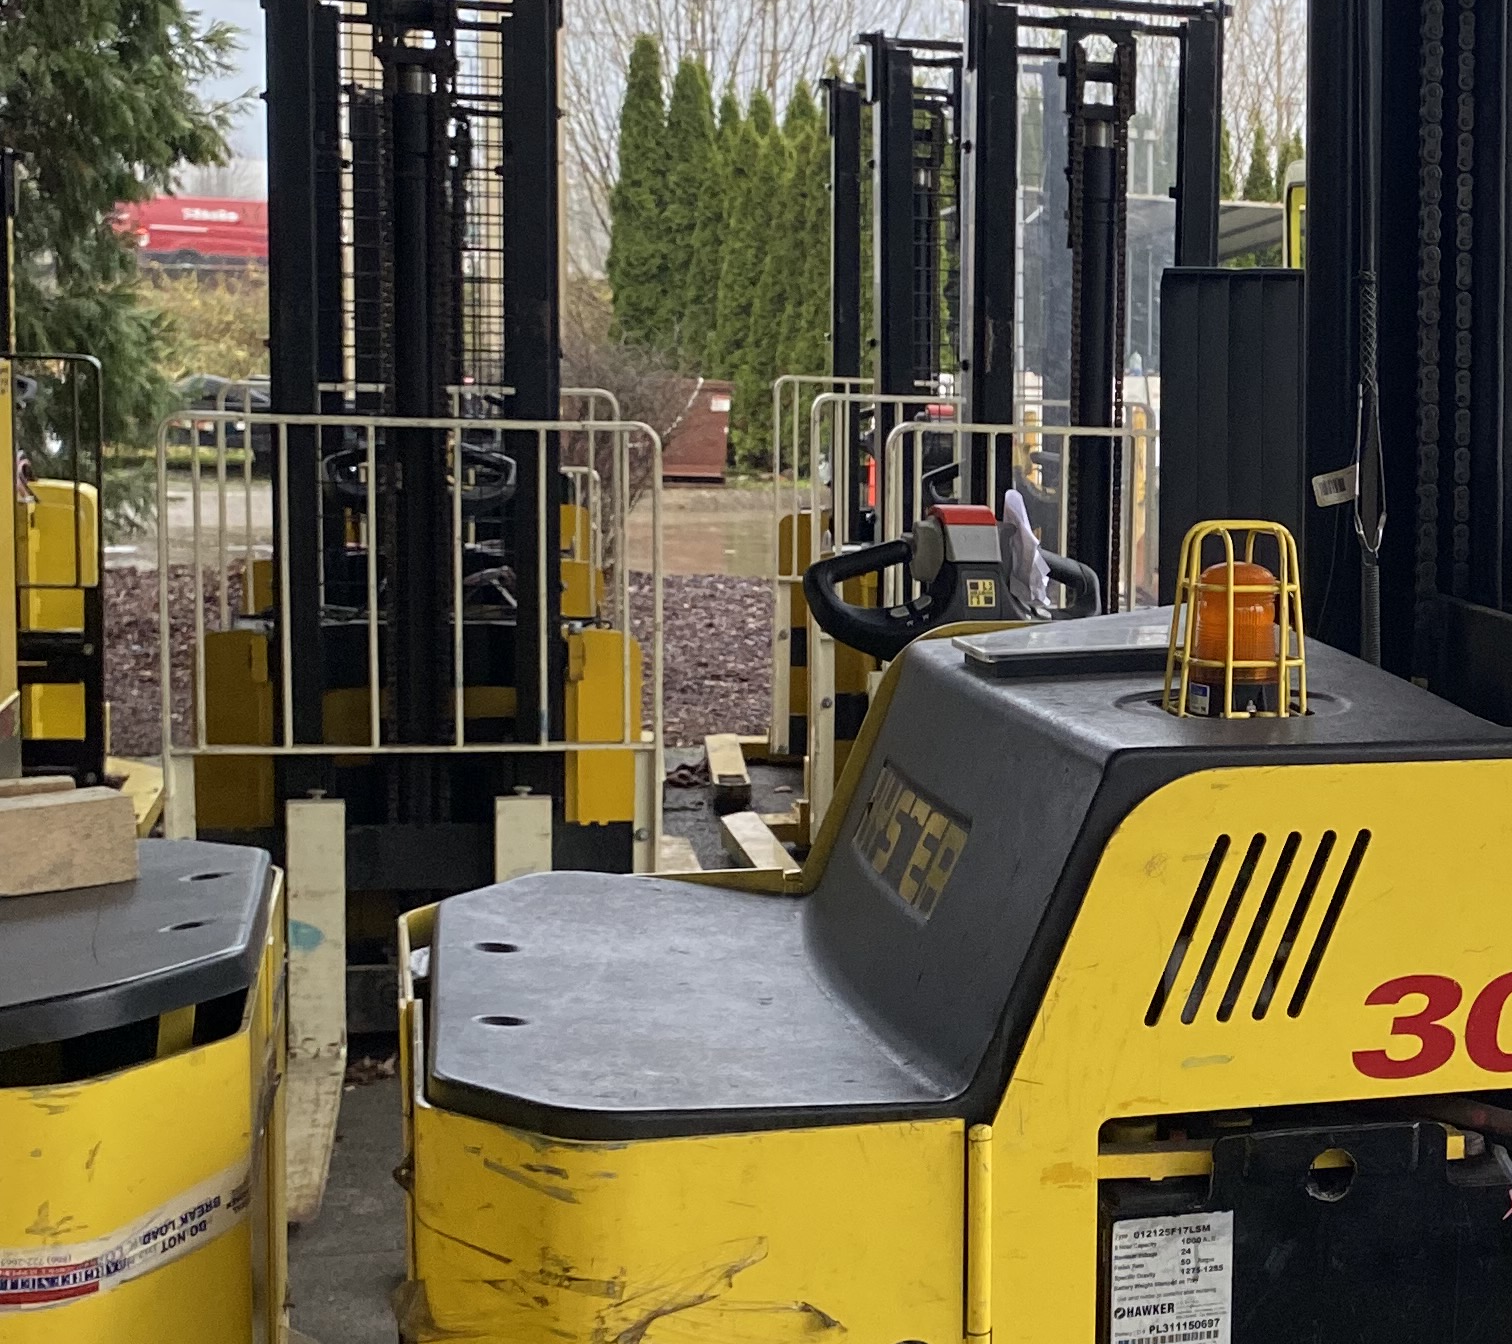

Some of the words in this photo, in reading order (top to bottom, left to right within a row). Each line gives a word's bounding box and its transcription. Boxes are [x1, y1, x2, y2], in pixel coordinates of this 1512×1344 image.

[180, 1195, 221, 1224] BREAK
[142, 1219, 176, 1245] LOAD
[190, 1219, 207, 1237] DO
[161, 1231, 186, 1254] NOT
[1126, 1302, 1175, 1318] HAWKER
